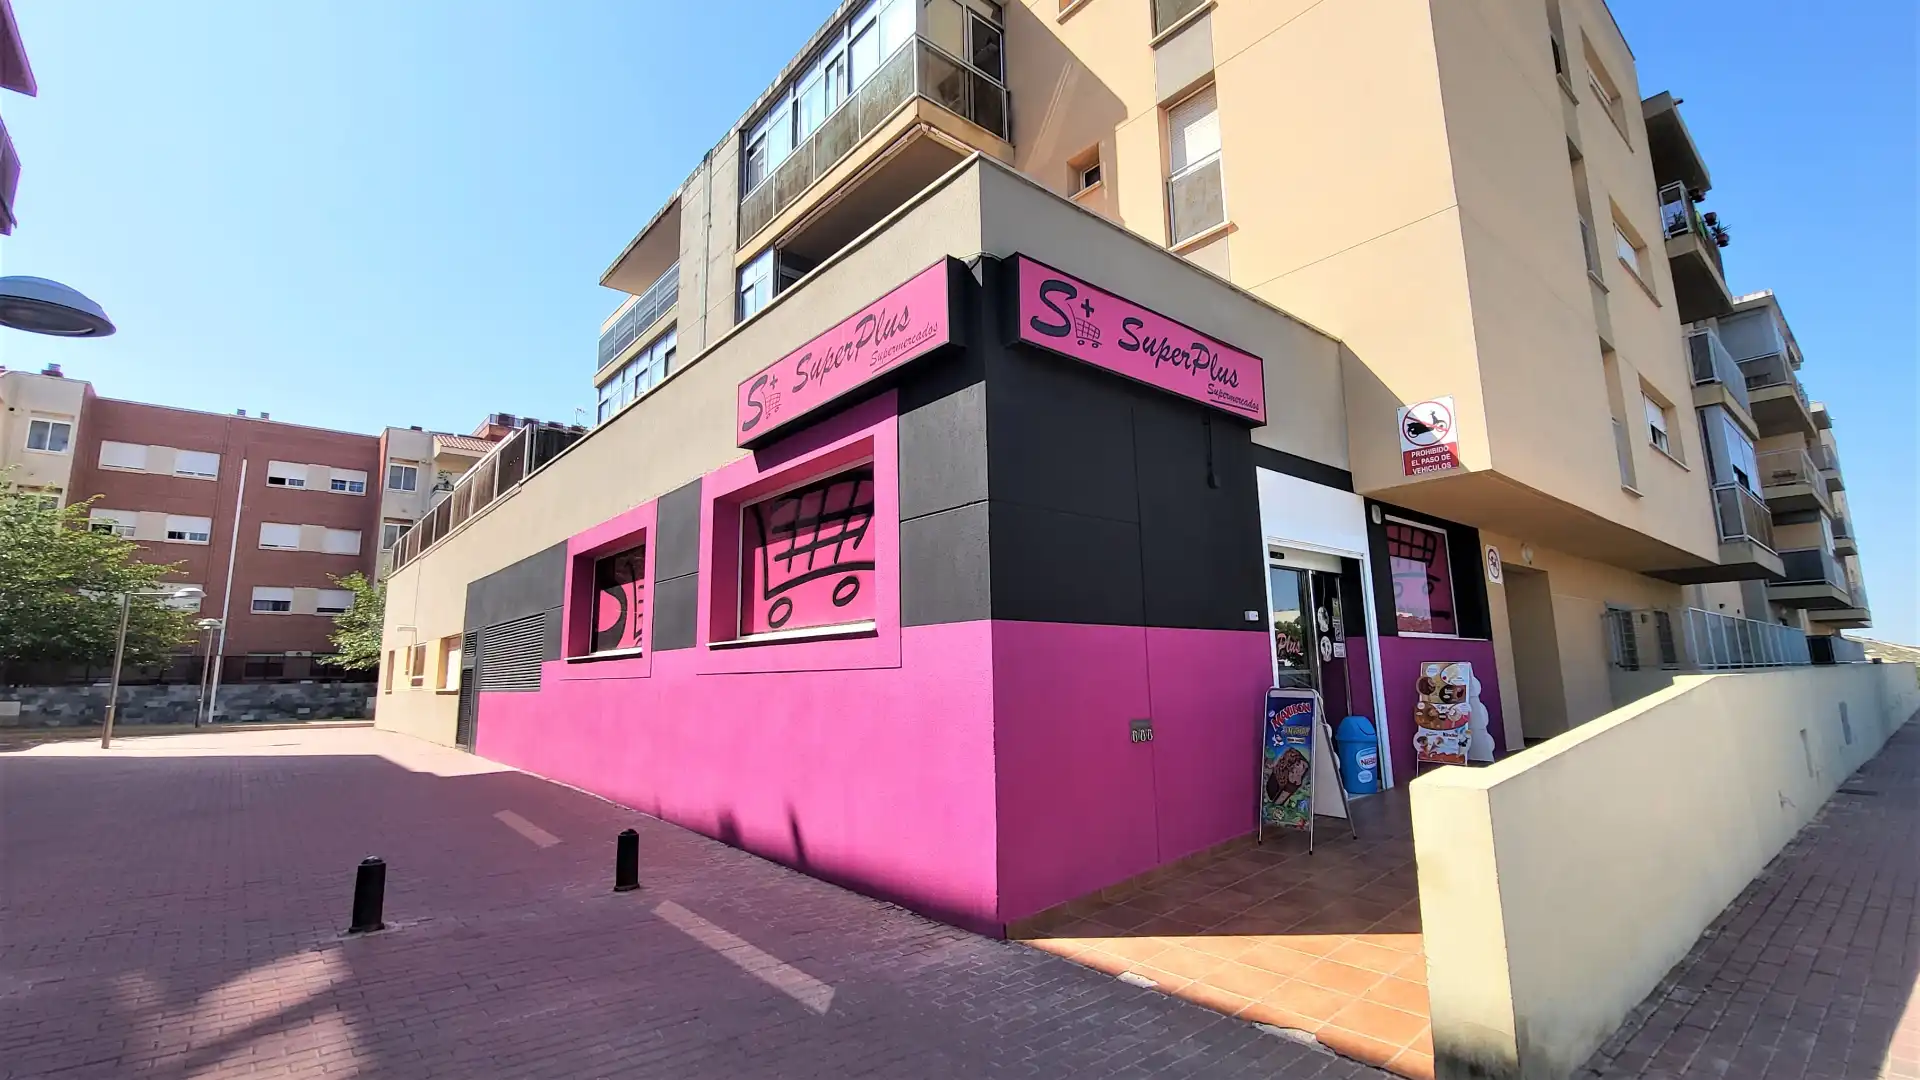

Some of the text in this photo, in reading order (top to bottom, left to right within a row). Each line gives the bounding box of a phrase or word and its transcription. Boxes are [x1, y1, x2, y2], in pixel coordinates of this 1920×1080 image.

[792, 304, 912, 393] SuperPlus
[869, 321, 939, 367] Supermercados
[1117, 316, 1240, 389] SuperPlus
[1207, 383, 1260, 411] Supermercados
[1411, 445, 1449, 459] PROHIBIDO
[1411, 453, 1451, 467] EL PASO DE
[1412, 461, 1452, 475] VEHICULOS
[1271, 702, 1311, 732] MAXIBON
